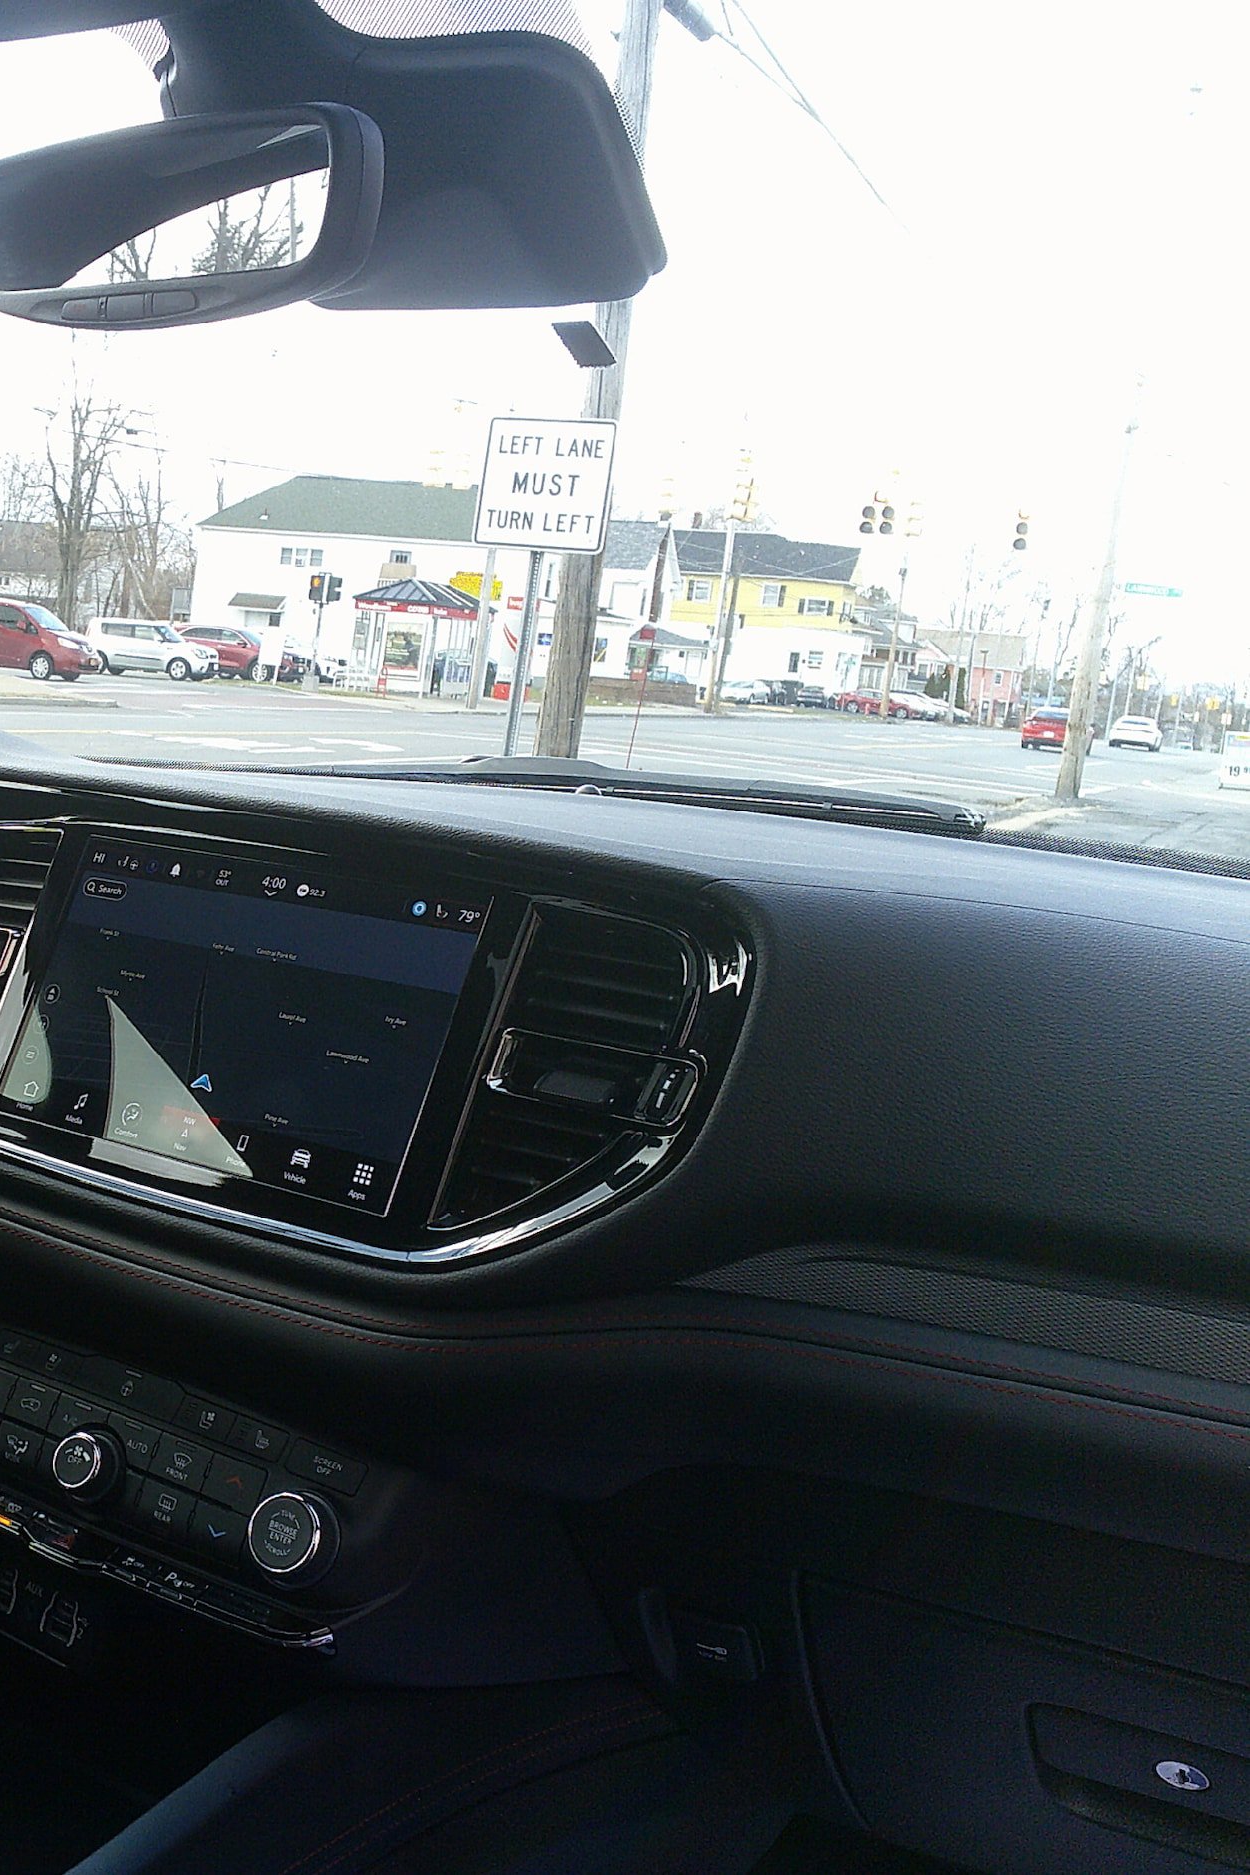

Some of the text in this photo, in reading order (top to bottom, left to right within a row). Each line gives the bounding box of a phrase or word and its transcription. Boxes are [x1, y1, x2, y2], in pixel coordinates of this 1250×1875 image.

[498, 434, 605, 458] LEFT LANE
[512, 472, 580, 496] MUST
[487, 508, 595, 534] TURN LEFT
[92, 852, 106, 863] HI
[97, 884, 122, 896] Search
[261, 876, 287, 890] 4:00
[458, 909, 481, 923] 79°
[114, 1127, 138, 1138] Comfort
[173, 1142, 187, 1151] Nav
[283, 1171, 307, 1184] Vehicle
[347, 1189, 366, 1201] Apps
[126, 1440, 148, 1454] AUTO
[313, 1455, 344, 1472] SCREEN
[316, 1465, 333, 1476] OFF
[165, 1466, 188, 1481] FRONT
